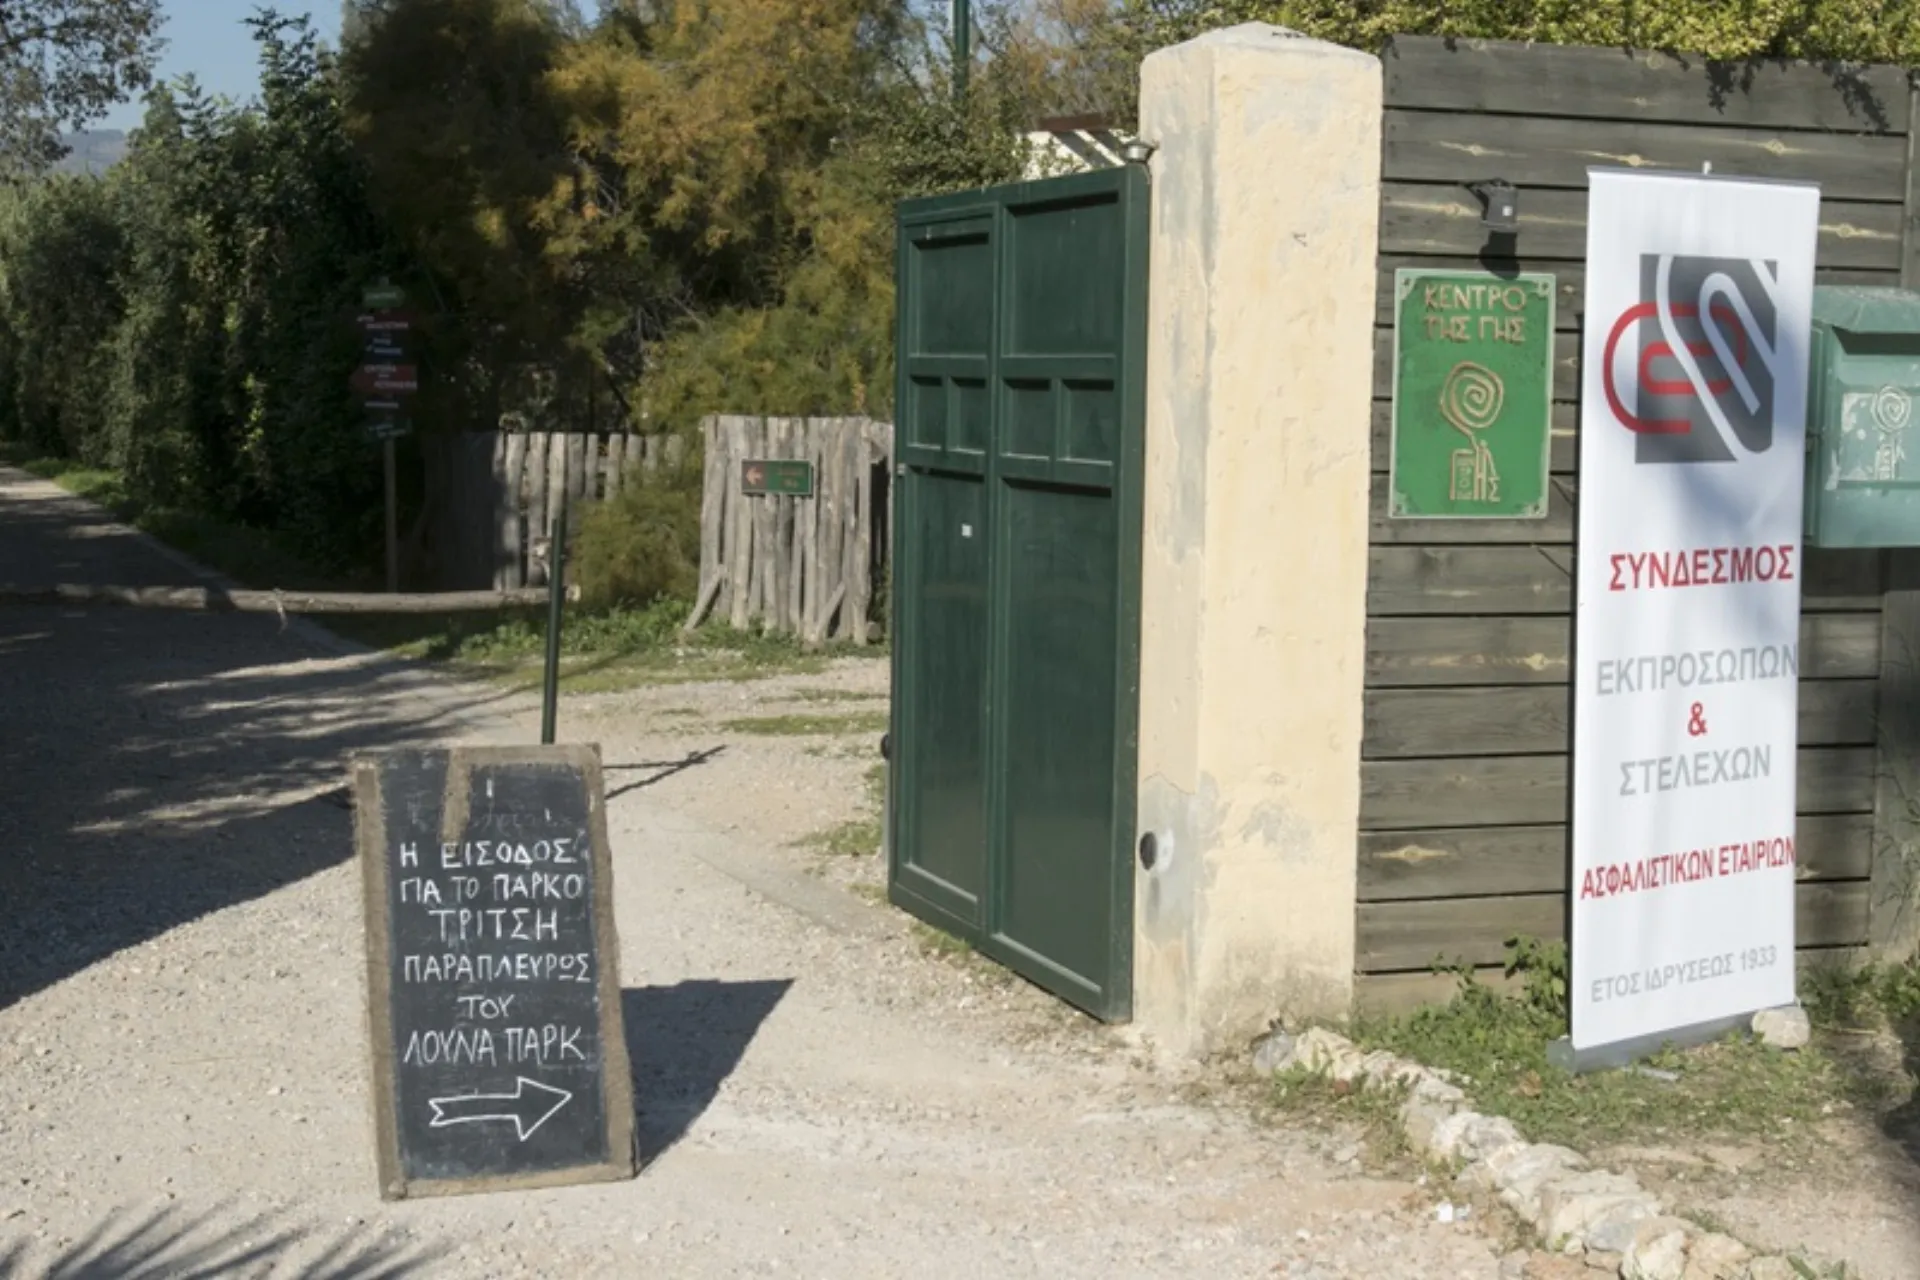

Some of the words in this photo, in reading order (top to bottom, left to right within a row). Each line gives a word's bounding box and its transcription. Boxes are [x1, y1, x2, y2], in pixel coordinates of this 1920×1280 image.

[1424, 283, 1527, 311] ΚΕΝΤΡΟ
[1424, 315, 1471, 341] ΤΗΣ
[1478, 316, 1527, 343] ΓΗΣ
[1608, 545, 1794, 591] ΣΥΝΔΕΣΜΟΣ
[1596, 643, 1797, 697] ΕΚΠΡΟΣΩΠΩΝ
[1687, 701, 1707, 736] &
[1619, 744, 1771, 796] ΣΤΕΛΕΧΩΝ
[400, 842, 418, 868] Η
[441, 838, 577, 869] ΕΙΣΟΔΟΣ
[1580, 847, 1715, 900] ΑΣΦΑΛΙΣΤΙΚΩΝ
[1718, 835, 1796, 877] ΕΤΑΙΡΙΩΝ
[451, 876, 480, 901] ΤΟ
[493, 872, 583, 901] ΠΑΡΚΟ
[428, 908, 558, 941] ΤΡΙΤΣΗ
[404, 953, 591, 983] ΠΑΡΑΠΛΕΥΡΩΣ
[1591, 971, 1641, 1003] ΕΤΟΣ
[1644, 952, 1735, 992] ΙΔΡΥΣΕΩΣ
[1740, 944, 1777, 972] 1933
[457, 993, 515, 1019] ΤΟΥ
[403, 1027, 497, 1067] ΛΟΥΝΑ
[504, 1023, 587, 1065] ΠΑΡΚ
